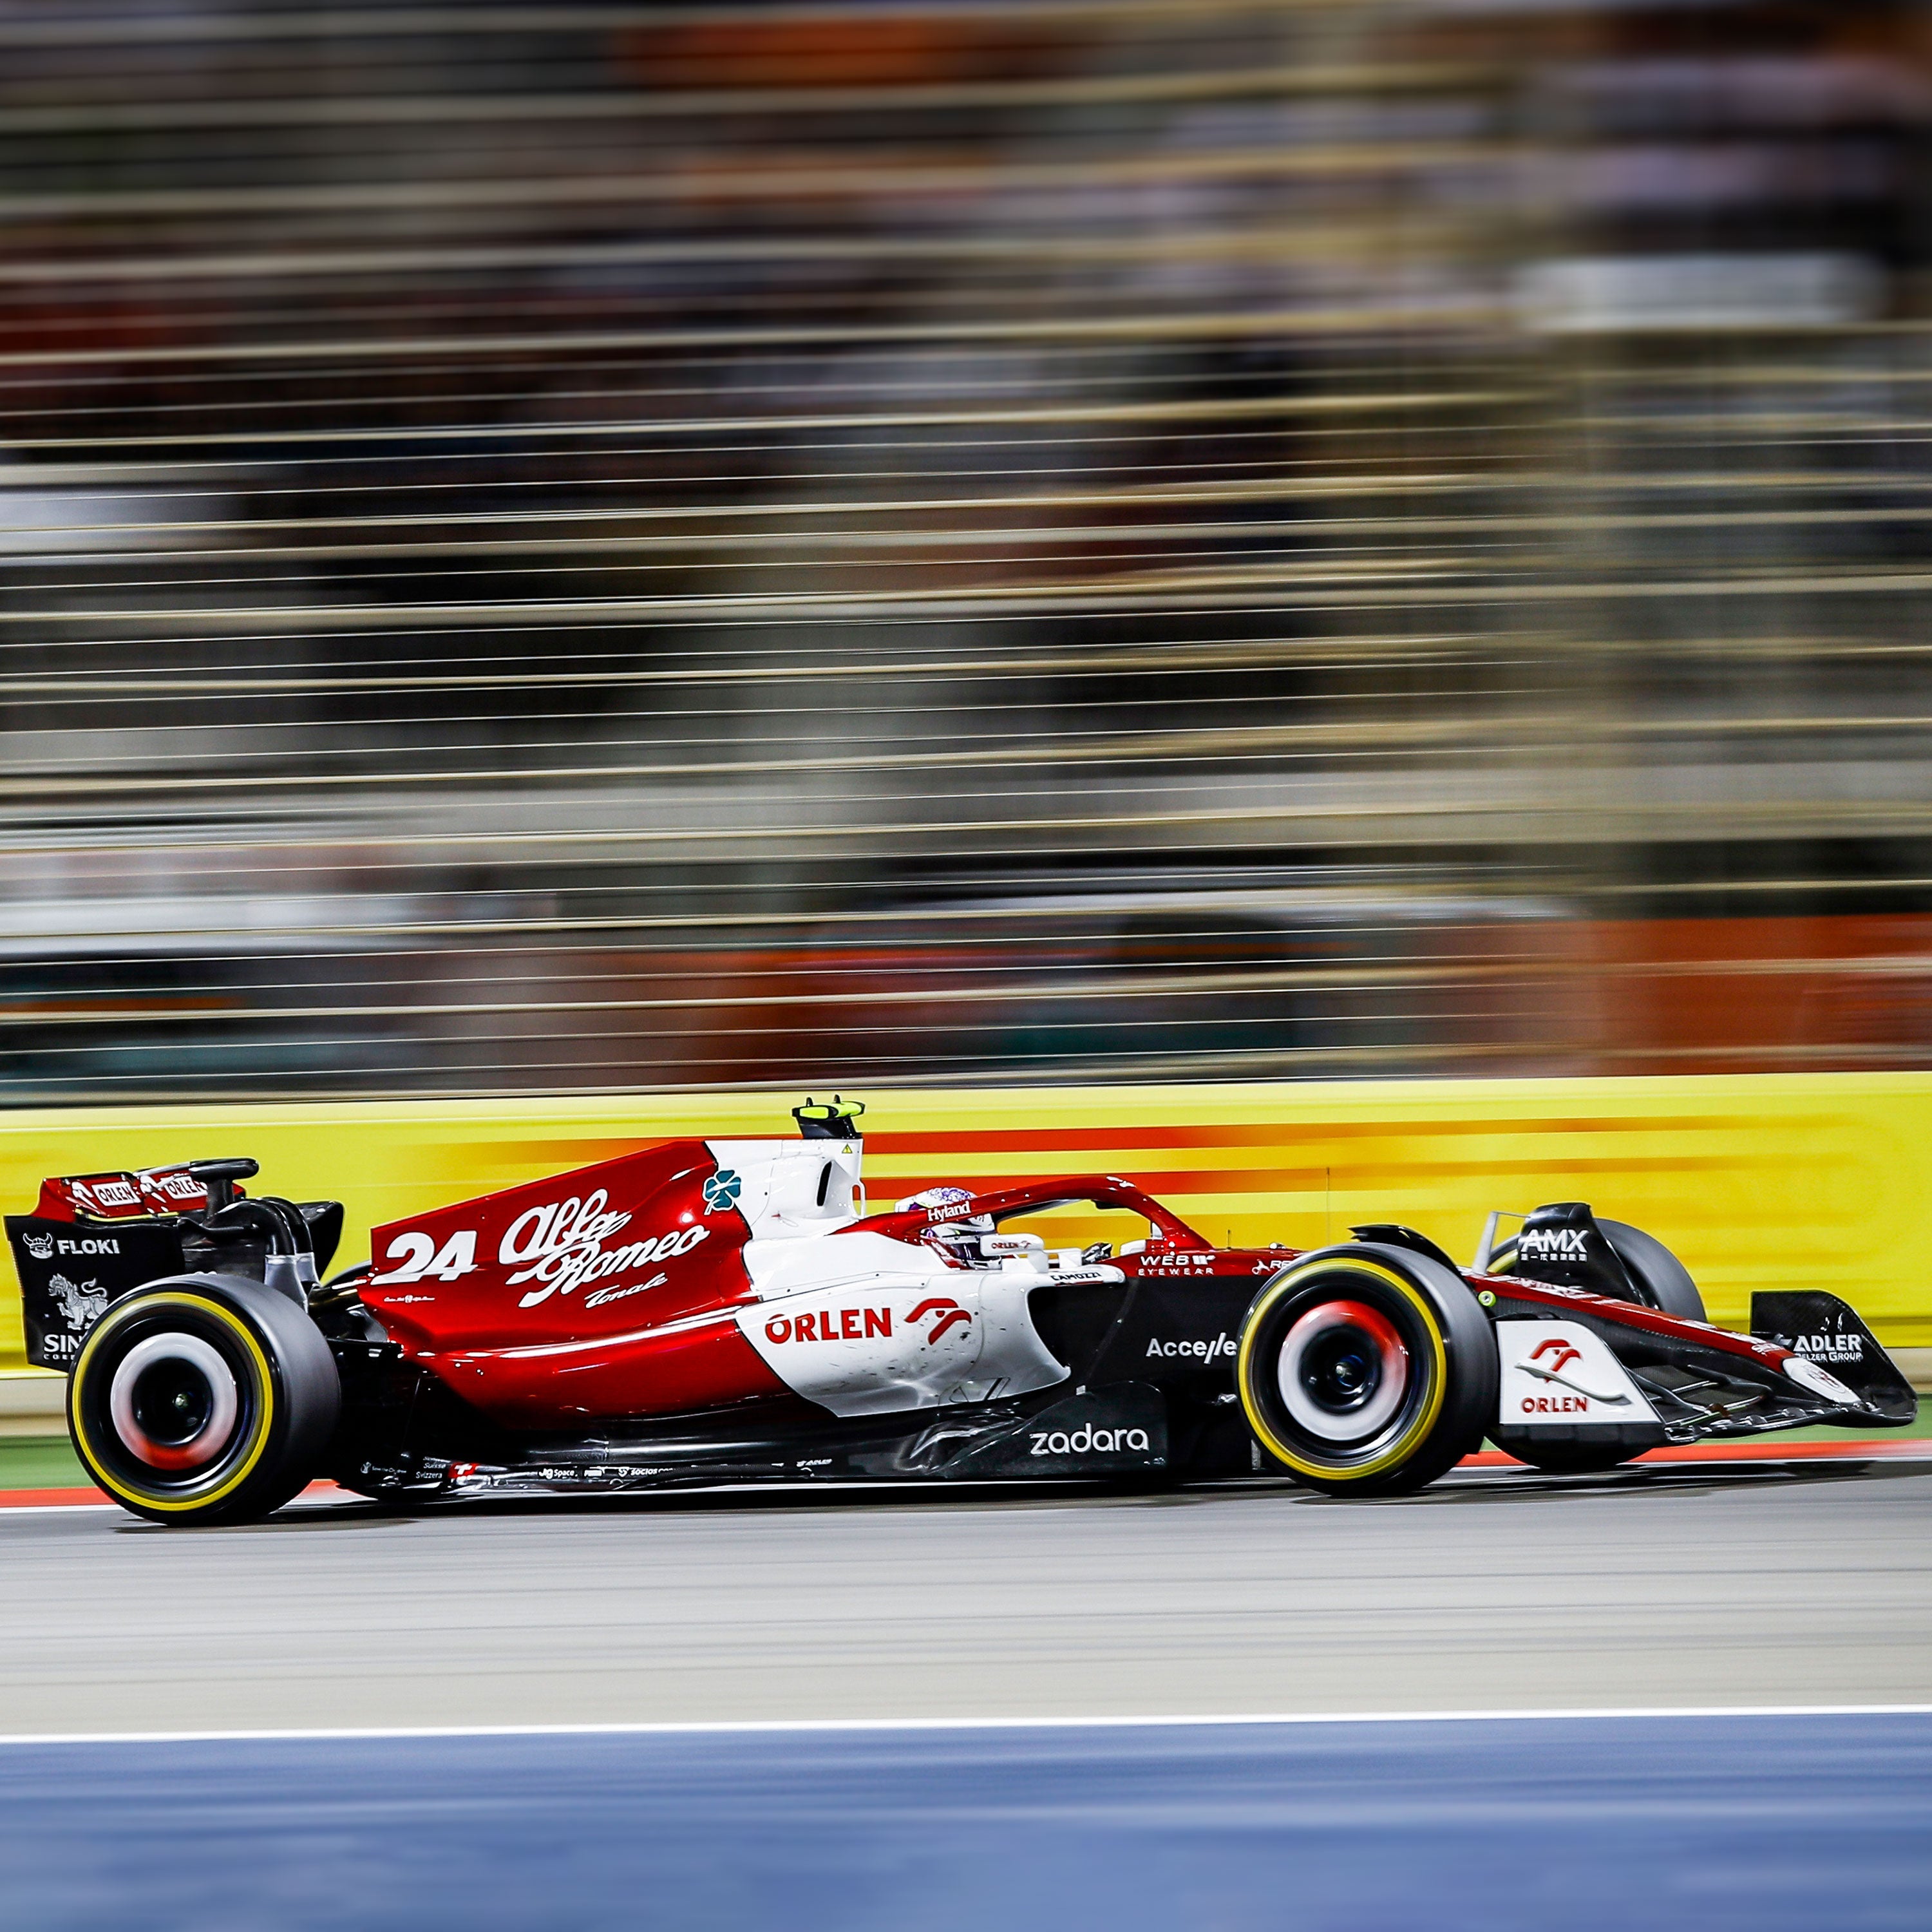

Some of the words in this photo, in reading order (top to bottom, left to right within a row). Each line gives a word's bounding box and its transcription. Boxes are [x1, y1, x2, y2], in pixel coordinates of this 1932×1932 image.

[98, 1184, 136, 1202] ORLEN
[927, 1201, 971, 1222] Hyland
[498, 1188, 632, 1264] Alfa
[57, 1239, 121, 1255] FLOKI
[1520, 1229, 1589, 1253] AMX
[370, 1230, 478, 1285] 24
[505, 1224, 710, 1308] Romeo
[1140, 1256, 1190, 1266] WEB
[1050, 1272, 1102, 1282] CAMOZZI
[584, 1272, 668, 1309] Tonale
[764, 1307, 893, 1345] ORLEN
[1794, 1334, 1862, 1352] ADLER
[1520, 1397, 1588, 1414] ORLEN
[1029, 1423, 1149, 1455] zadara
